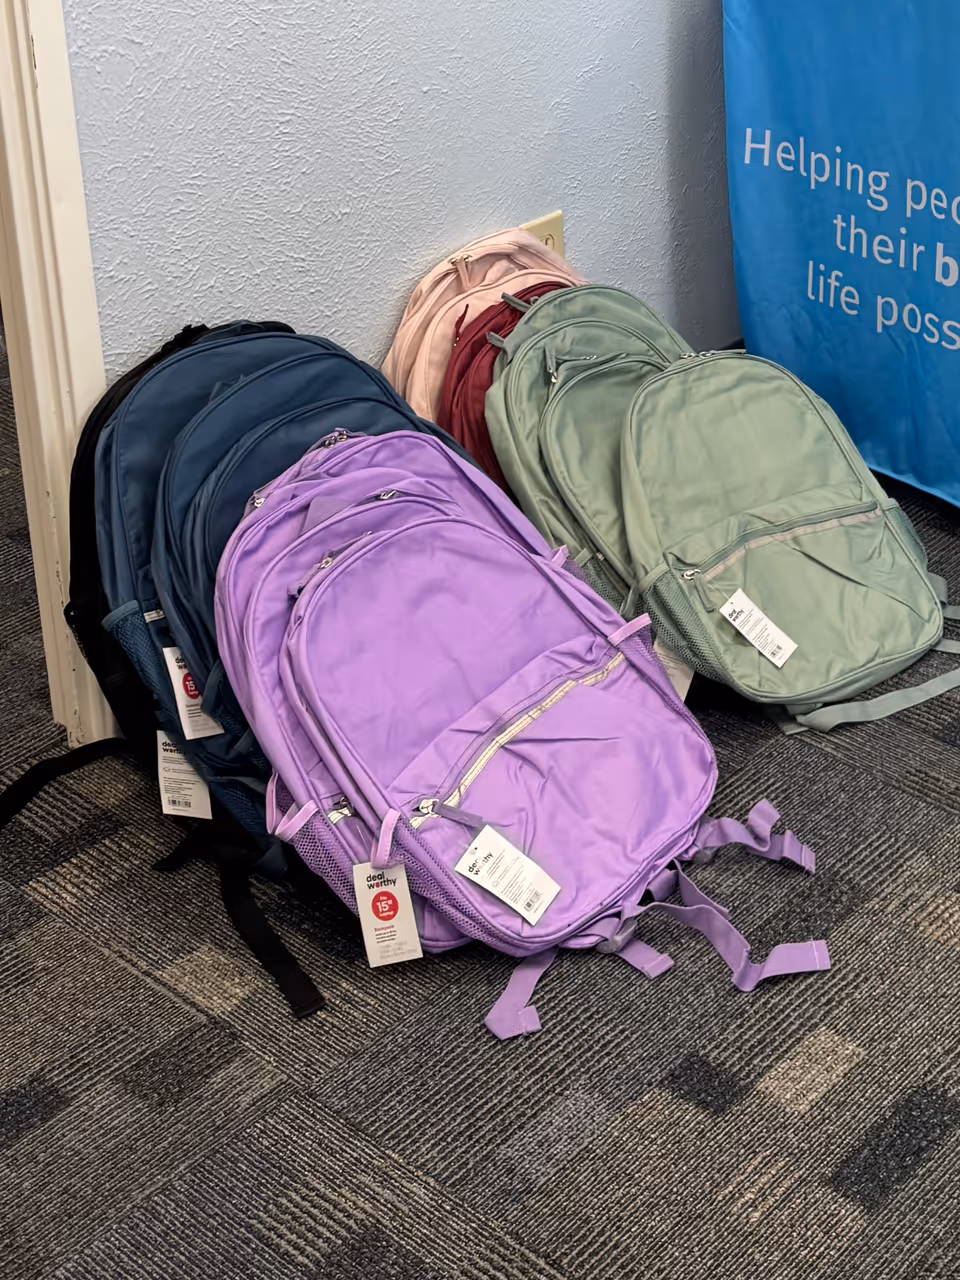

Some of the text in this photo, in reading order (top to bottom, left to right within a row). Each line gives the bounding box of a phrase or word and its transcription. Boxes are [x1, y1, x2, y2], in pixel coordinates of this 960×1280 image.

[743, 127, 891, 212] Helping
[833, 214, 925, 271] their
[806, 259, 861, 316] life
[366, 871, 385, 882] deal
[366, 878, 397, 890] worthy
